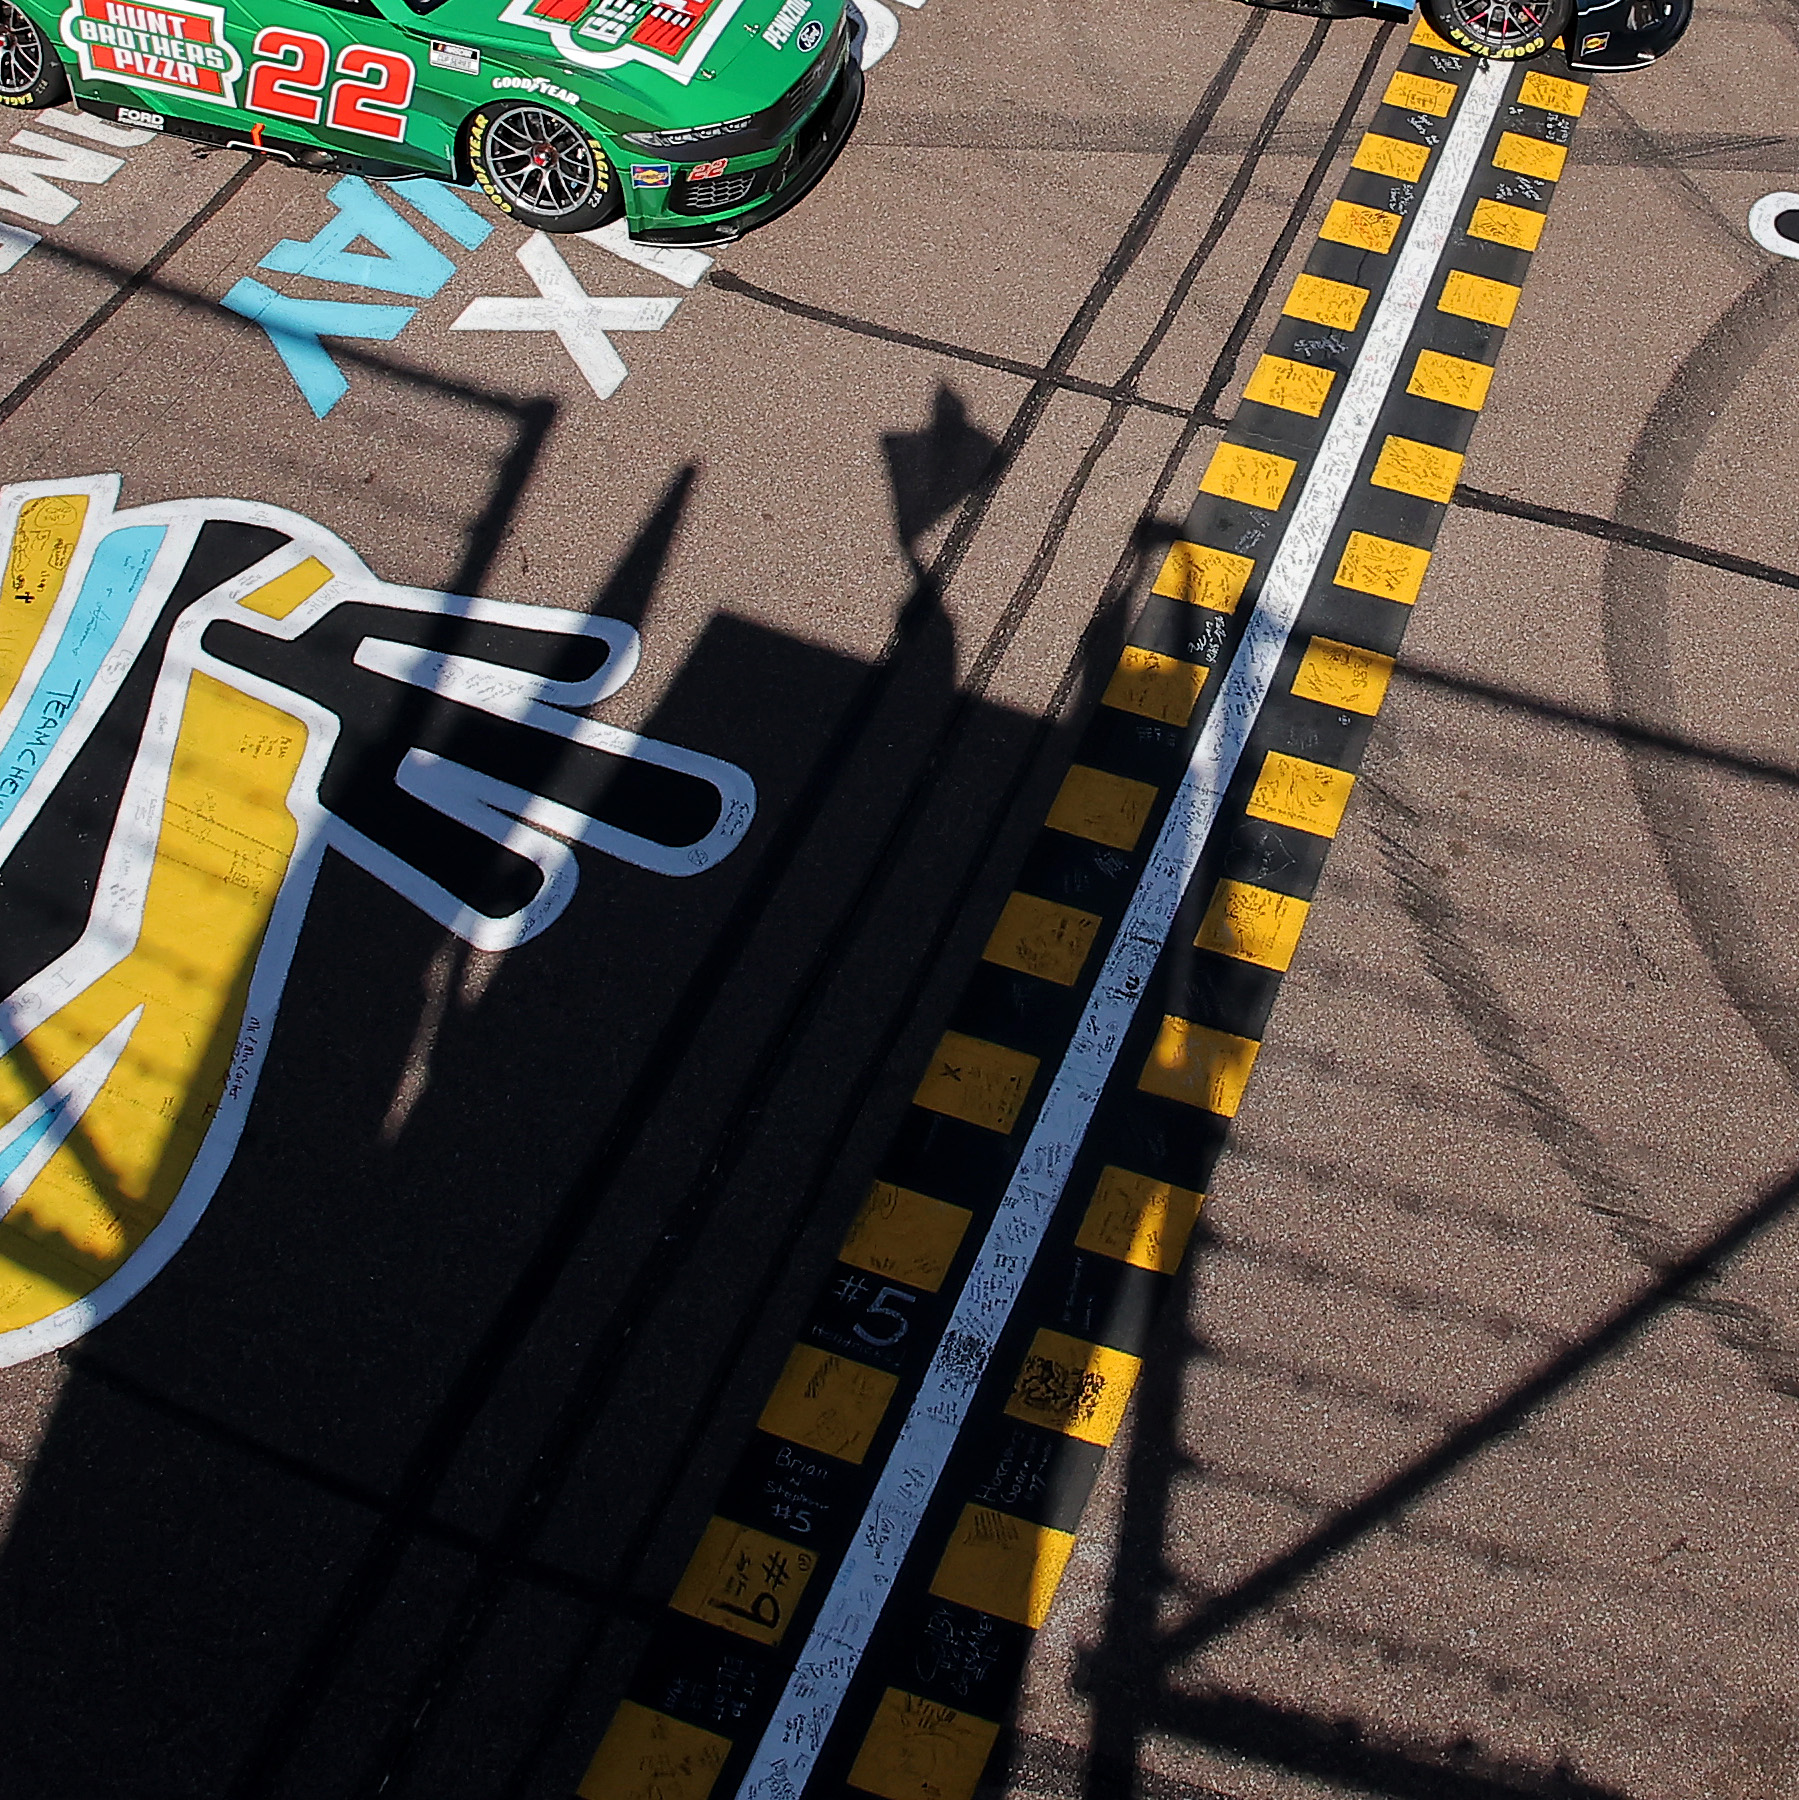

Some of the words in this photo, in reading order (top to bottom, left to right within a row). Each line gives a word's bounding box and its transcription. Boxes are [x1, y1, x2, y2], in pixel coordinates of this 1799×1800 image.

[106, 2, 187, 39] HUNT
[799, 26, 820, 46] Ford
[79, 20, 225, 70] BROTHERS
[114, 49, 199, 86] PIZZA
[245, 26, 416, 144] 22
[492, 77, 581, 106] GOODYEAR
[117, 108, 165, 126] FORD
[469, 114, 512, 214] GOODYEAR
[587, 139, 610, 194] EAGLE
[689, 160, 729, 180] 22
